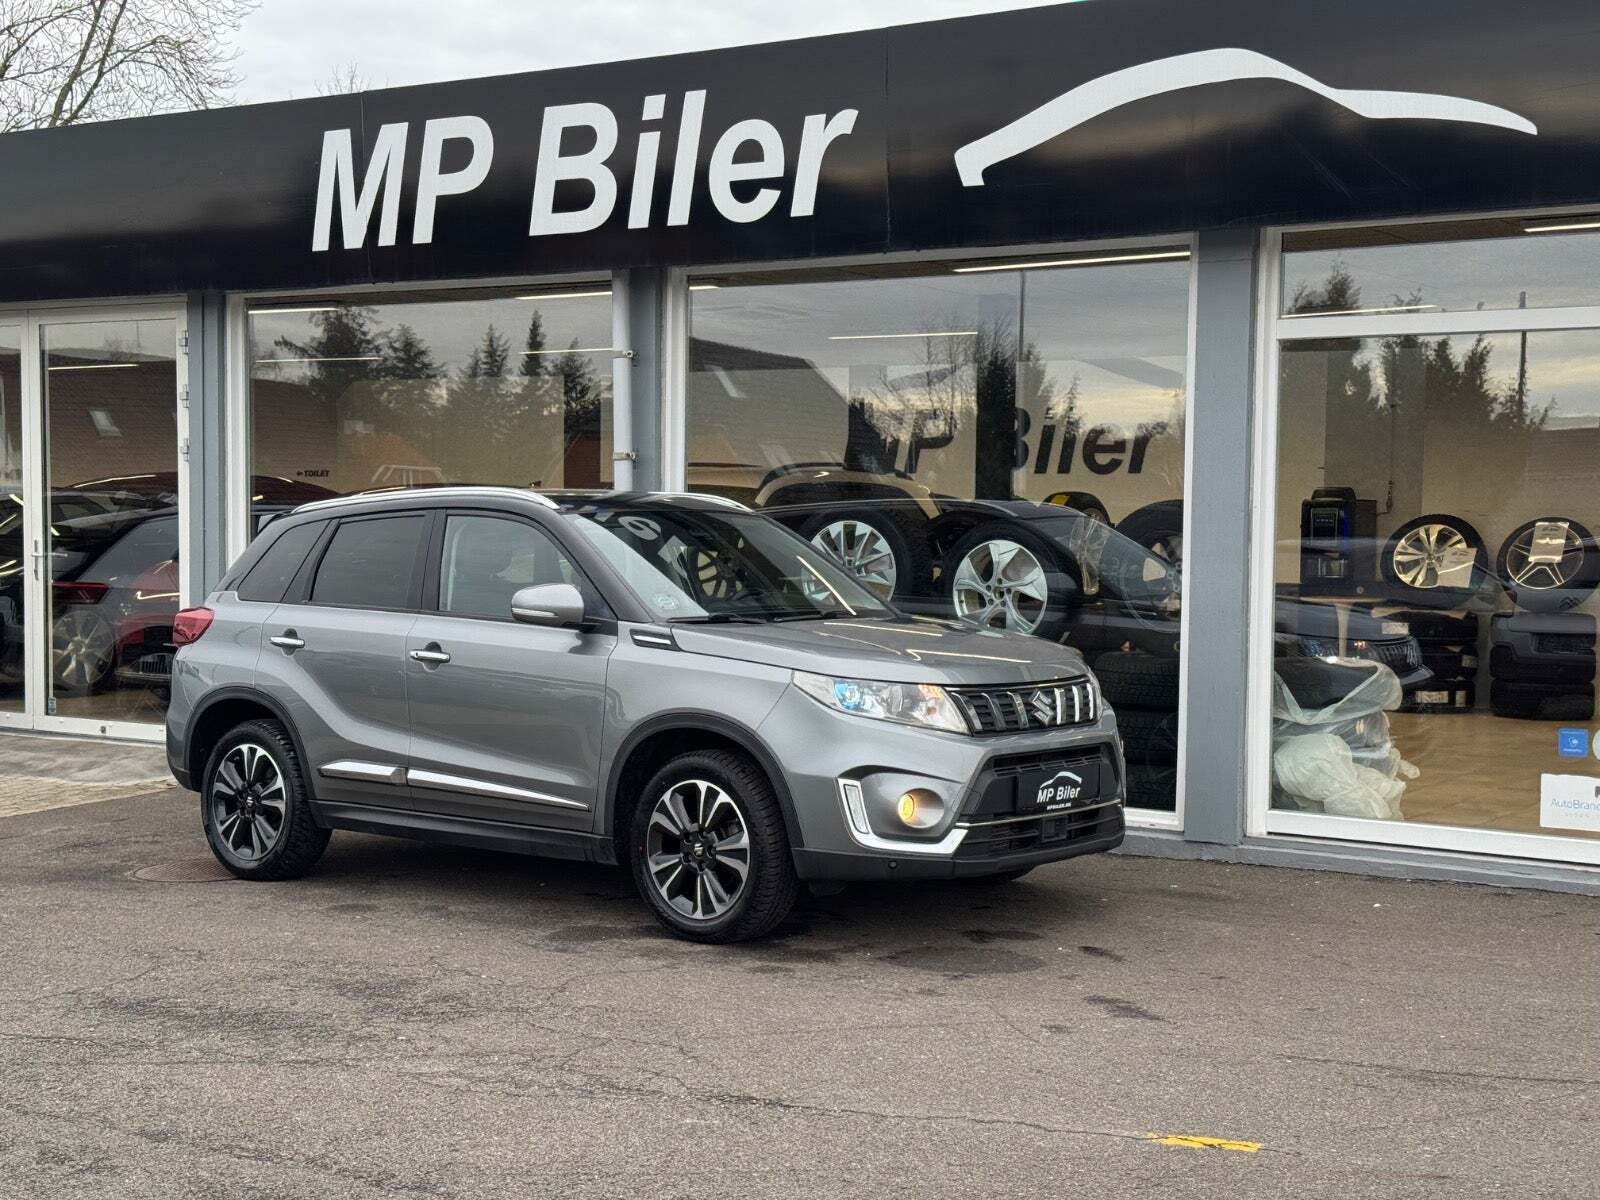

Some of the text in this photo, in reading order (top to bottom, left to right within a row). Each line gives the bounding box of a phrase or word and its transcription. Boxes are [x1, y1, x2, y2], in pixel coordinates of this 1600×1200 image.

[311, 89, 859, 252] MP Biler
[1037, 785, 1080, 803] MP Biler
